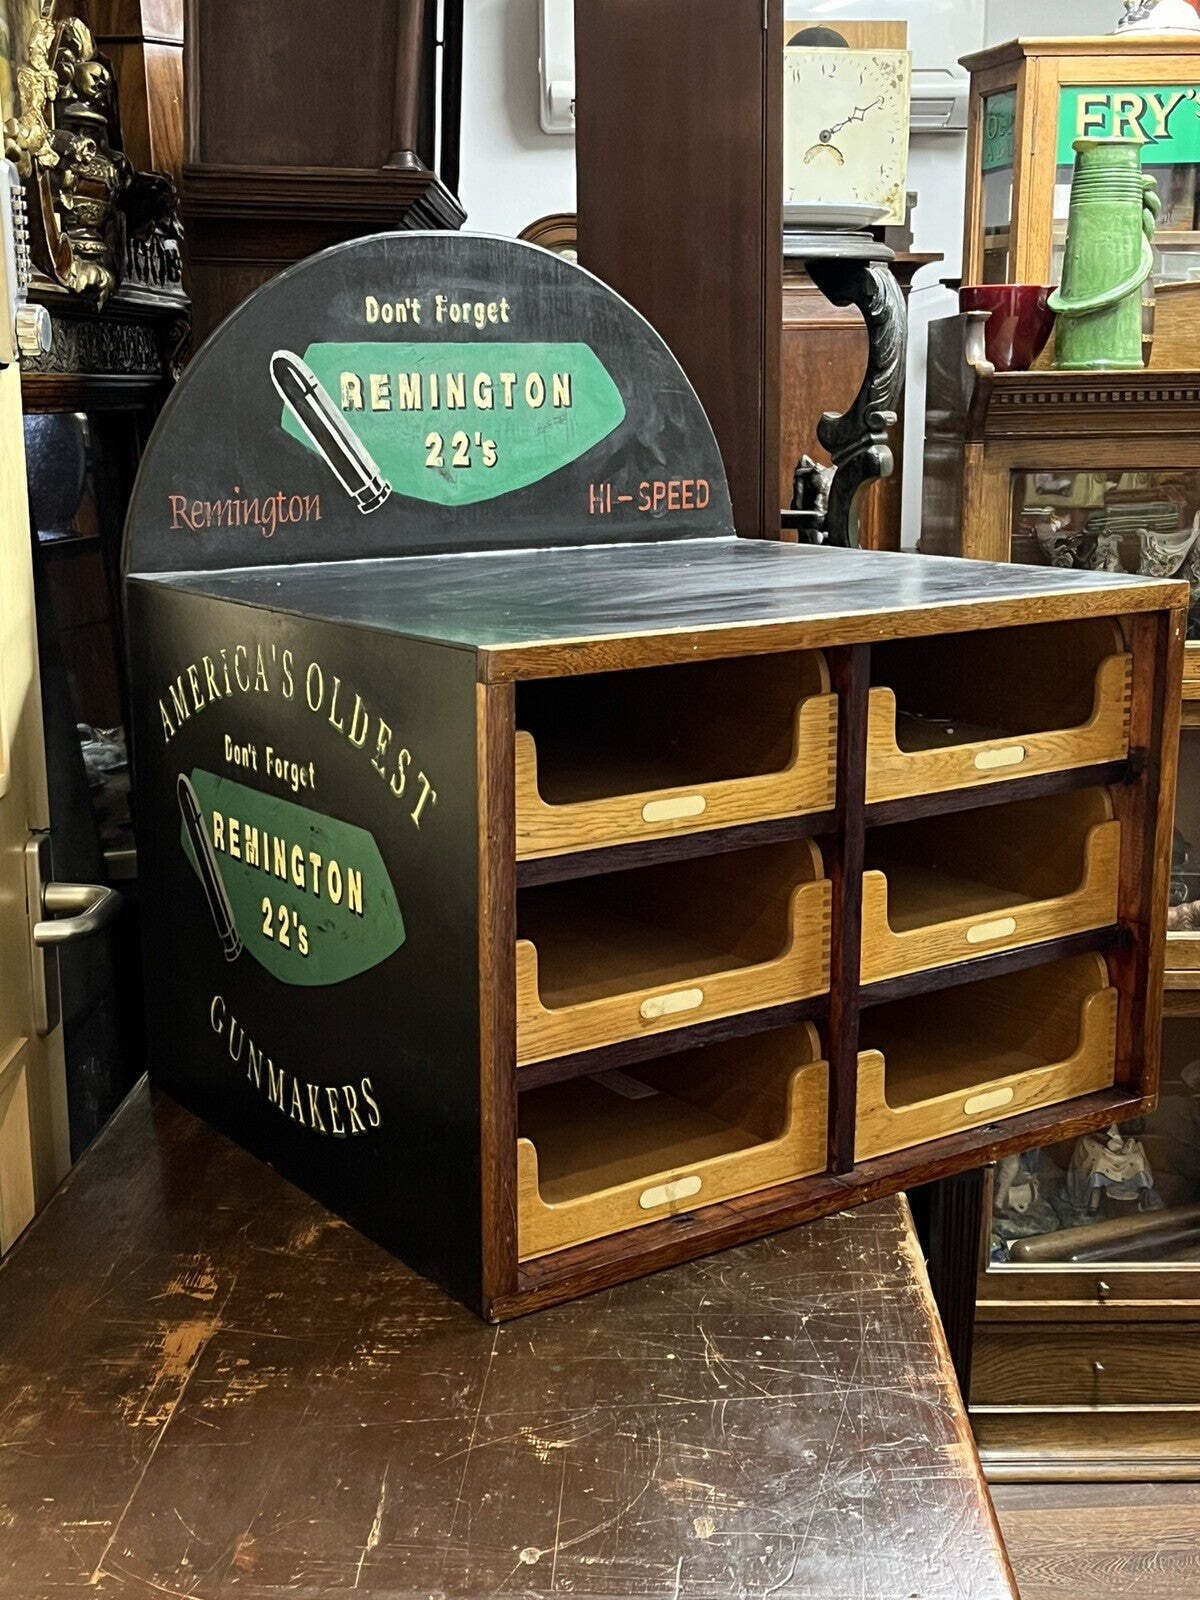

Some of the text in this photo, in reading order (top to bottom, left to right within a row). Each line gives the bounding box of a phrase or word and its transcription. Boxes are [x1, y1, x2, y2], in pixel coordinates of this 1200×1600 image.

[1076, 89, 1200, 144] FRY'
[365, 295, 510, 331] Don't Forget
[339, 372, 573, 412] REMINGTON
[424, 430, 499, 469] 22's
[168, 486, 322, 539] Remington
[159, 643, 438, 831] AMERICA'S OLDEST
[224, 734, 316, 793] Don't Forget
[212, 810, 364, 917] REMINGTON
[261, 896, 309, 957] 22's
[210, 995, 381, 1135] GUNMAKERS
